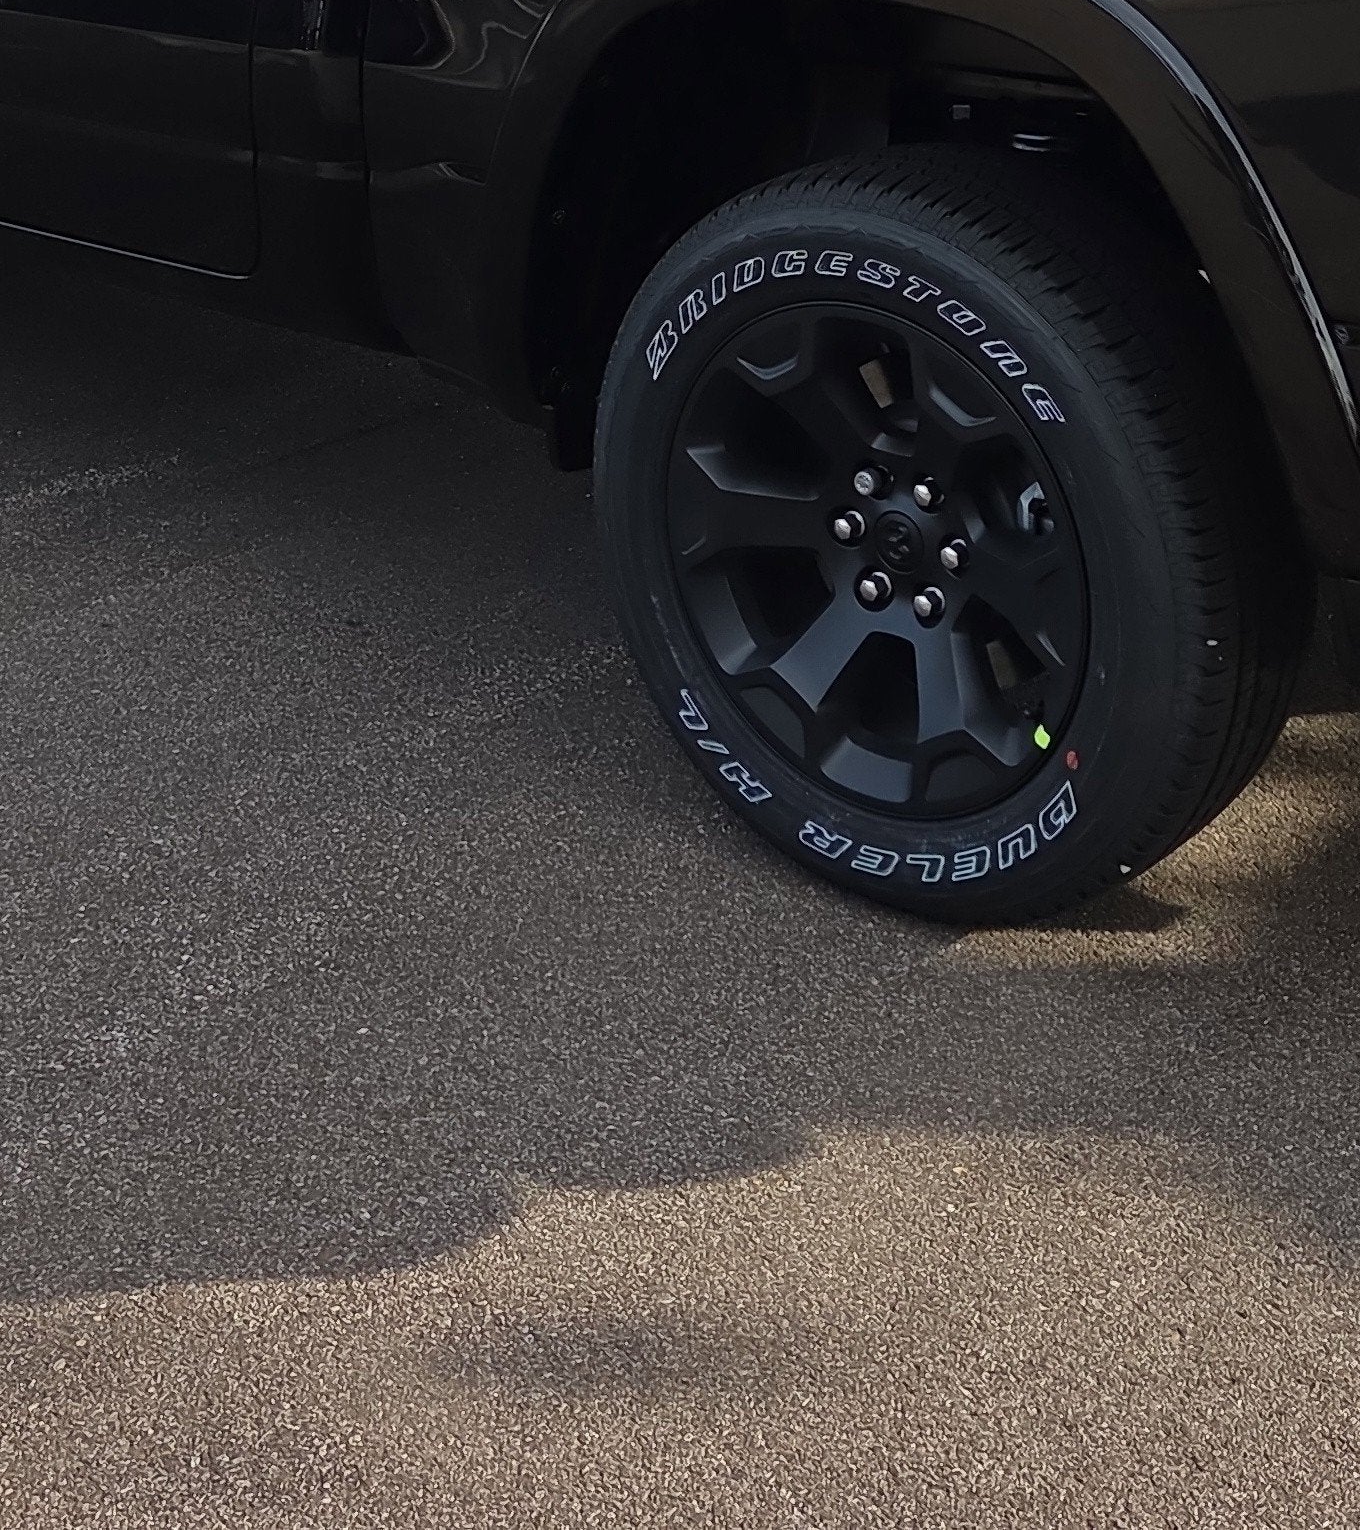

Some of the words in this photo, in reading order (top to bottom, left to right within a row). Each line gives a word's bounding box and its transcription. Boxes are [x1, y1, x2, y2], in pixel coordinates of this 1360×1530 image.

[645, 249, 1066, 423] BRIDGESTONE
[678, 688, 773, 804] H/L
[798, 780, 1077, 883] DUELER
